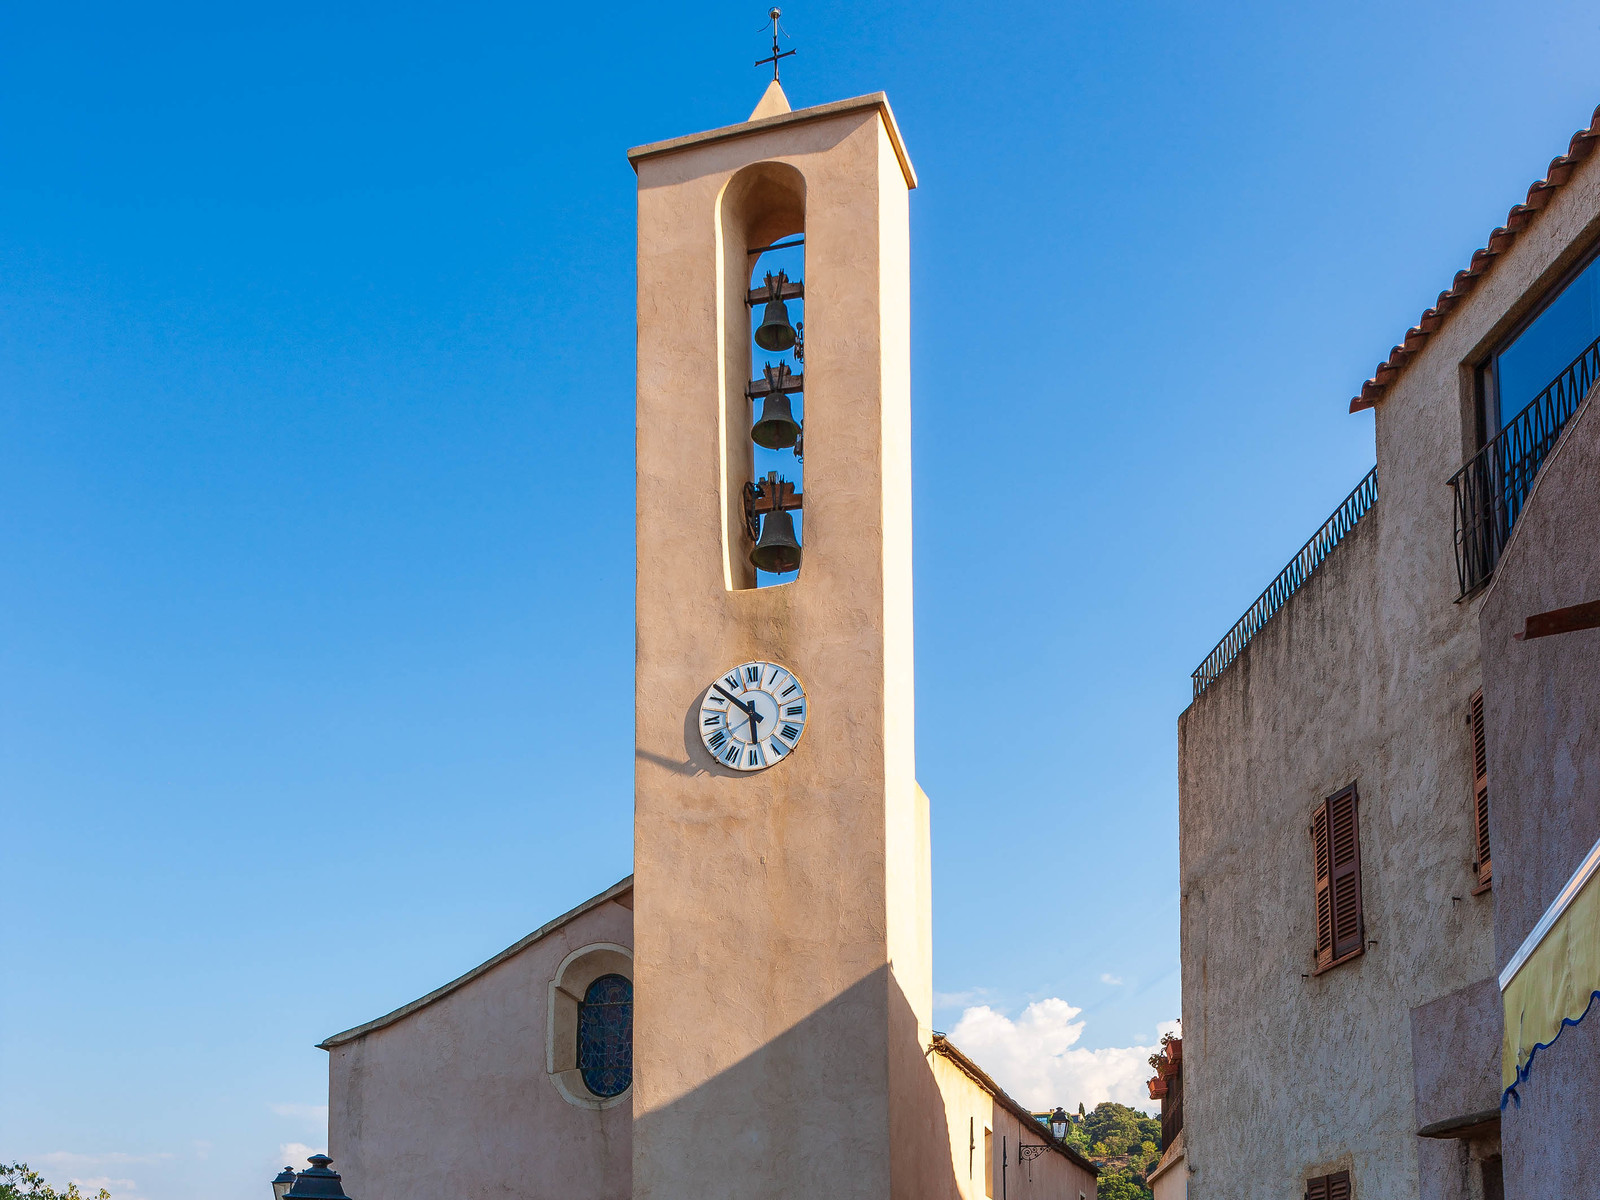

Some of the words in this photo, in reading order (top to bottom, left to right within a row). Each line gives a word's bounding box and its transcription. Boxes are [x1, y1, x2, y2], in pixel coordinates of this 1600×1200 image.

[747, 666, 758, 682] XII
[769, 670, 778, 685] I
[725, 675, 739, 691] XI
[781, 684, 797, 697] II
[710, 694, 725, 705] X
[787, 706, 802, 716] III
[704, 715, 720, 726] IX
[781, 724, 798, 740] IIII
[725, 746, 740, 763] VII
[750, 750, 758, 766] VI
